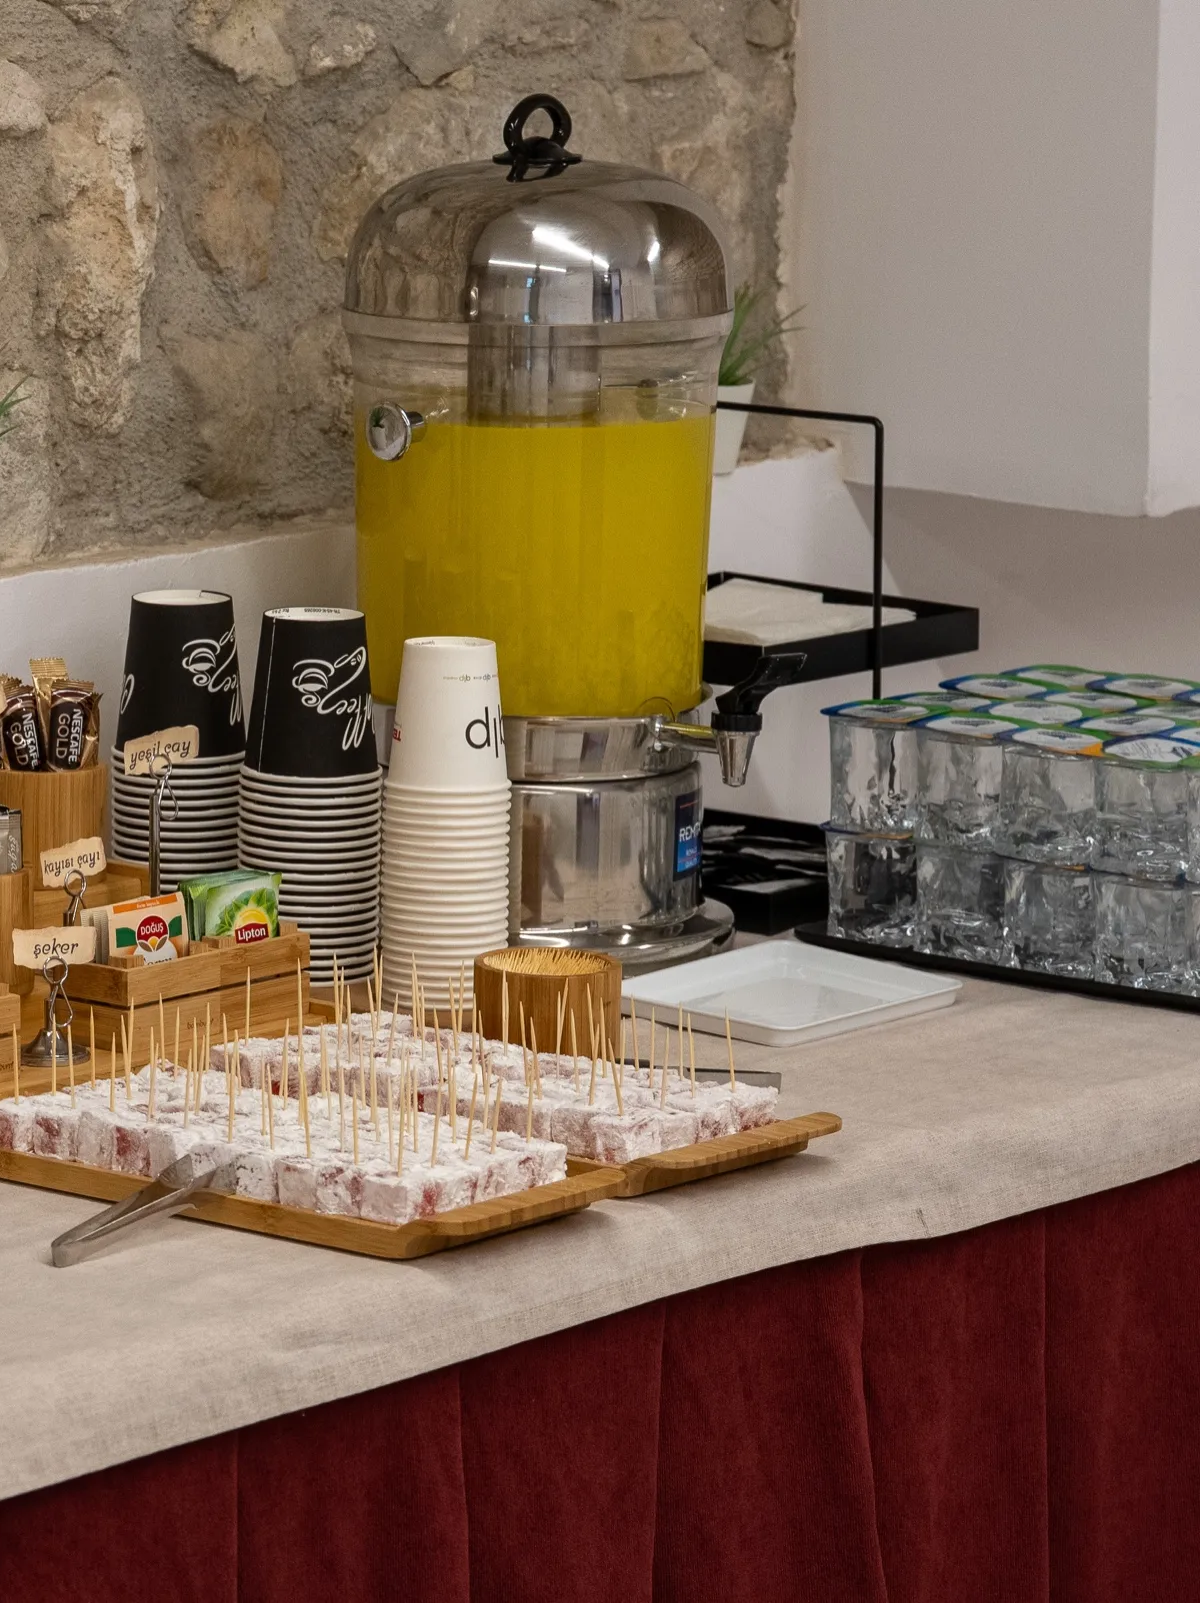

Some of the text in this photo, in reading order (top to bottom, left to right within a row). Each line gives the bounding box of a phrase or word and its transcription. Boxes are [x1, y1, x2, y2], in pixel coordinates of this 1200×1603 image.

[10, 722, 29, 766] GOLD
[56, 713, 71, 759] GOLD
[130, 741, 191, 770] yeşil çay
[44, 851, 100, 877] kayısı çayı
[140, 921, 164, 936] DOĞUŞ
[237, 927, 266, 942] Lipton
[33, 937, 79, 959] şeker
